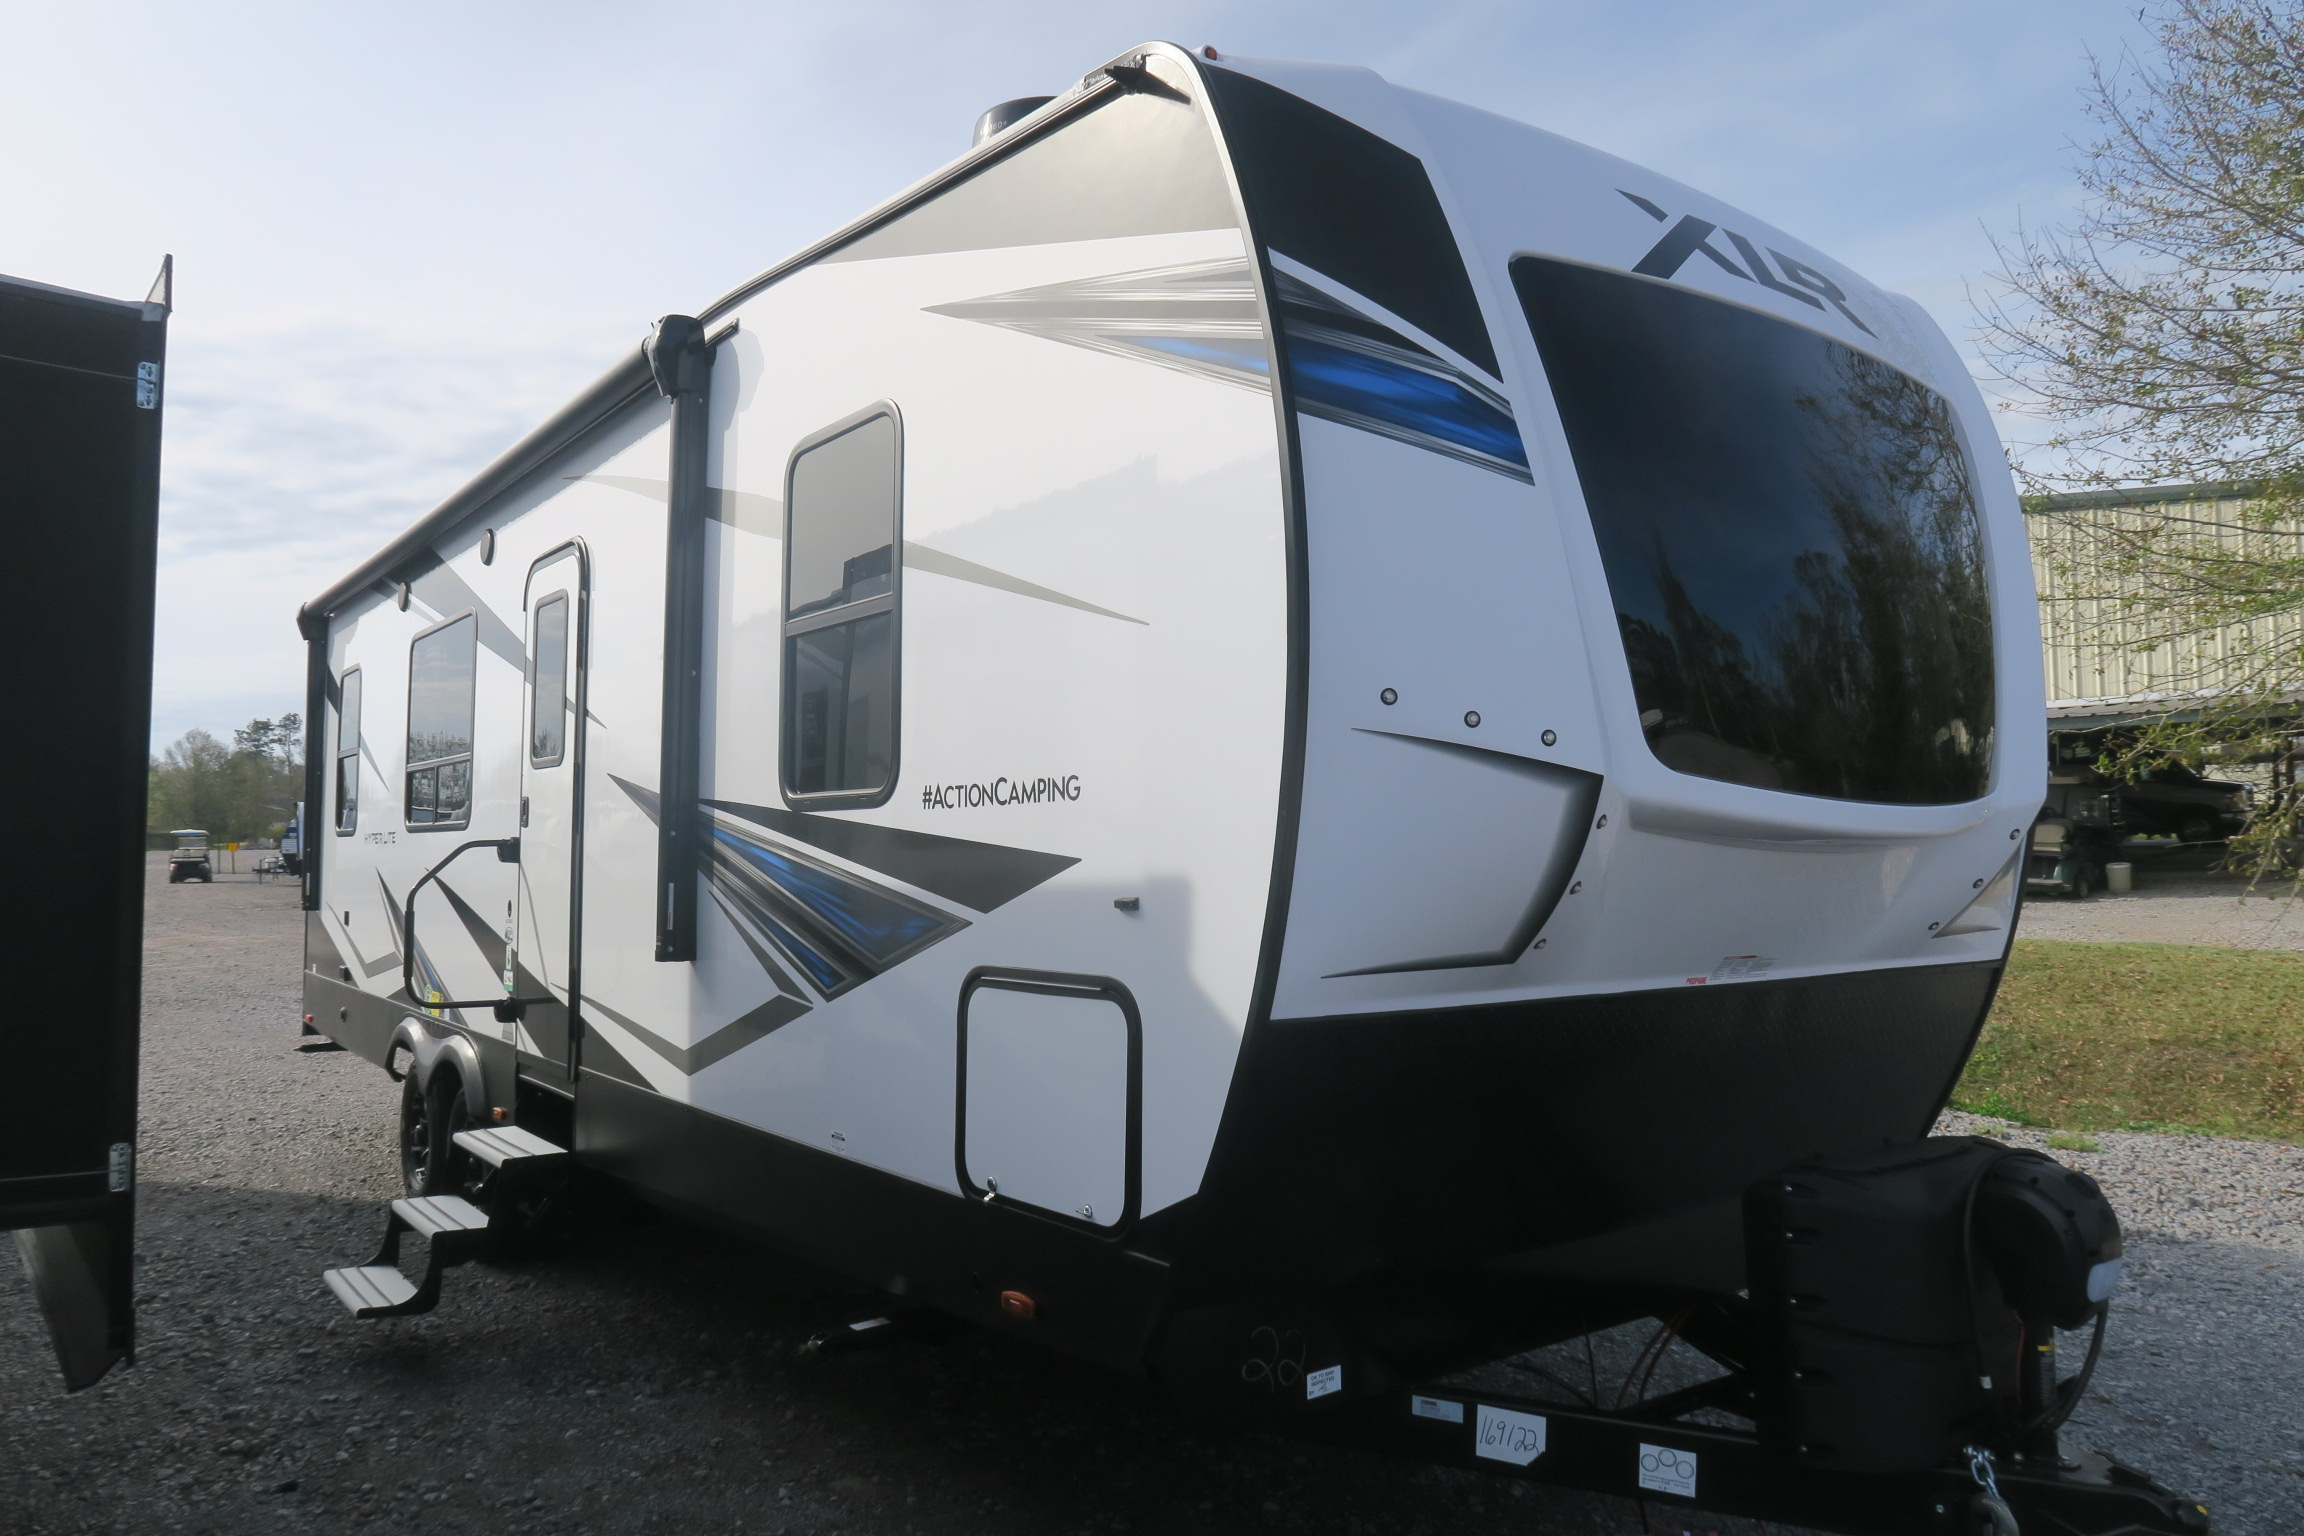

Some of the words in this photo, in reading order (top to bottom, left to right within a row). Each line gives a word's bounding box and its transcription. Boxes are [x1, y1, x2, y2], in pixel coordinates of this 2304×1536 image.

[1614, 188, 1879, 340] XLR
[1311, 1376, 1335, 1387] INSPECTED
[1479, 1415, 1540, 1454] 169122
